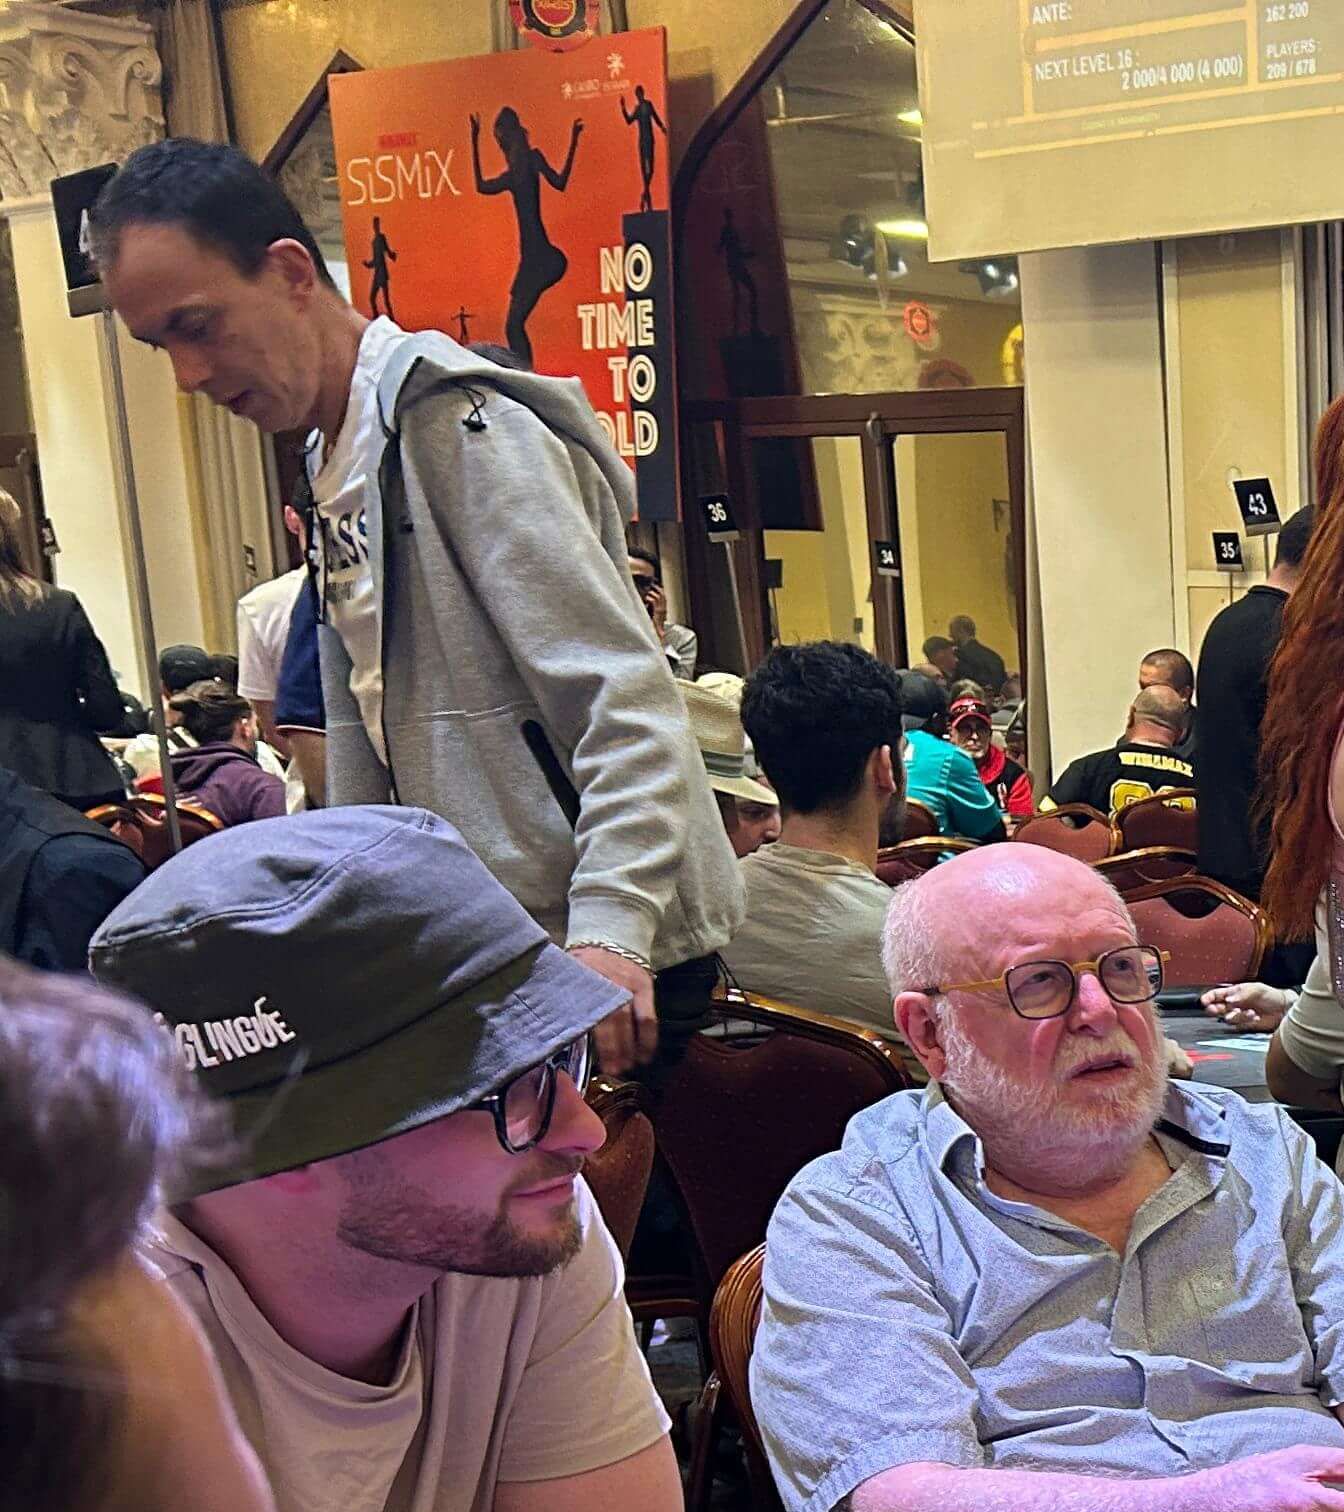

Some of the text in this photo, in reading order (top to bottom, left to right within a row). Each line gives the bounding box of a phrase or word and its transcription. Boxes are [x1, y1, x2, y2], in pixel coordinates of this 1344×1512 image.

[1032, 3, 1073, 25] ANTE:
[1034, 57, 1070, 82] NEXT
[1072, 52, 1114, 76] LEVEL
[1116, 49, 1133, 70] 16
[600, 242, 653, 293] NO
[577, 298, 655, 350] TIME
[607, 353, 657, 403] TO
[595, 410, 659, 458] OLD
[707, 502, 727, 523] 36
[1248, 493, 1268, 516] 43
[1220, 542, 1236, 559] 35
[174, 996, 297, 1073] GLINGUÉ
